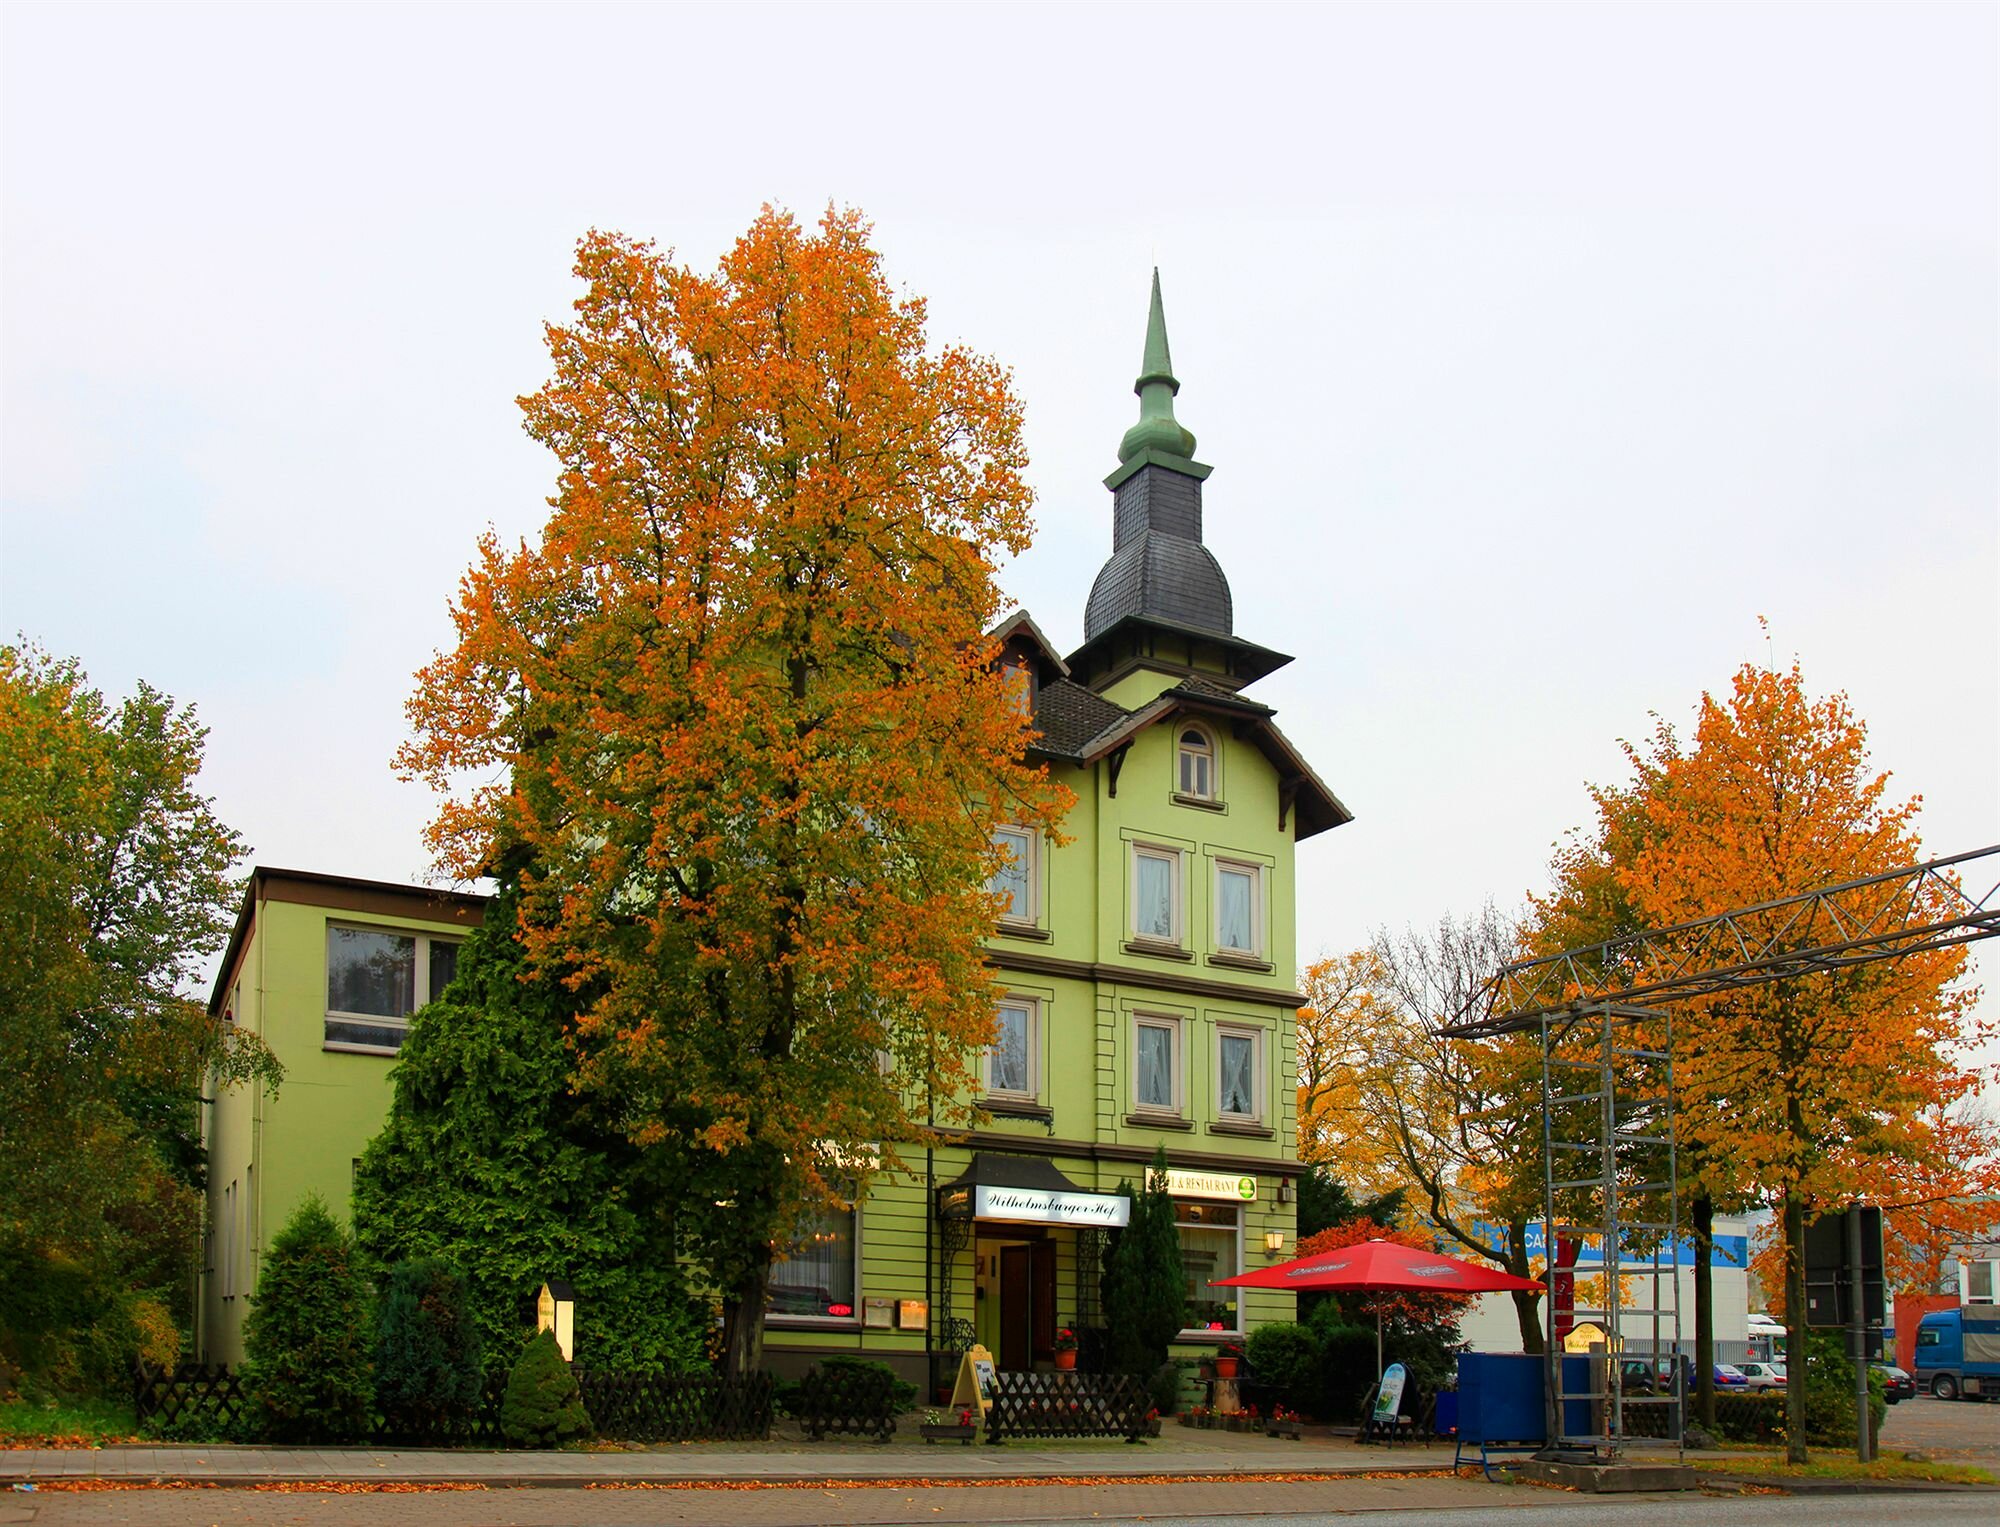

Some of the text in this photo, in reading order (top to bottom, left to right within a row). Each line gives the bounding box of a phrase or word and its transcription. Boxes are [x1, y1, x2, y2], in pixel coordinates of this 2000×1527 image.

[1177, 1178, 1184, 1189] &
[1186, 1176, 1235, 1193] RESTAURANT
[987, 1192, 1121, 1219] Wilhelmsburger Hof
